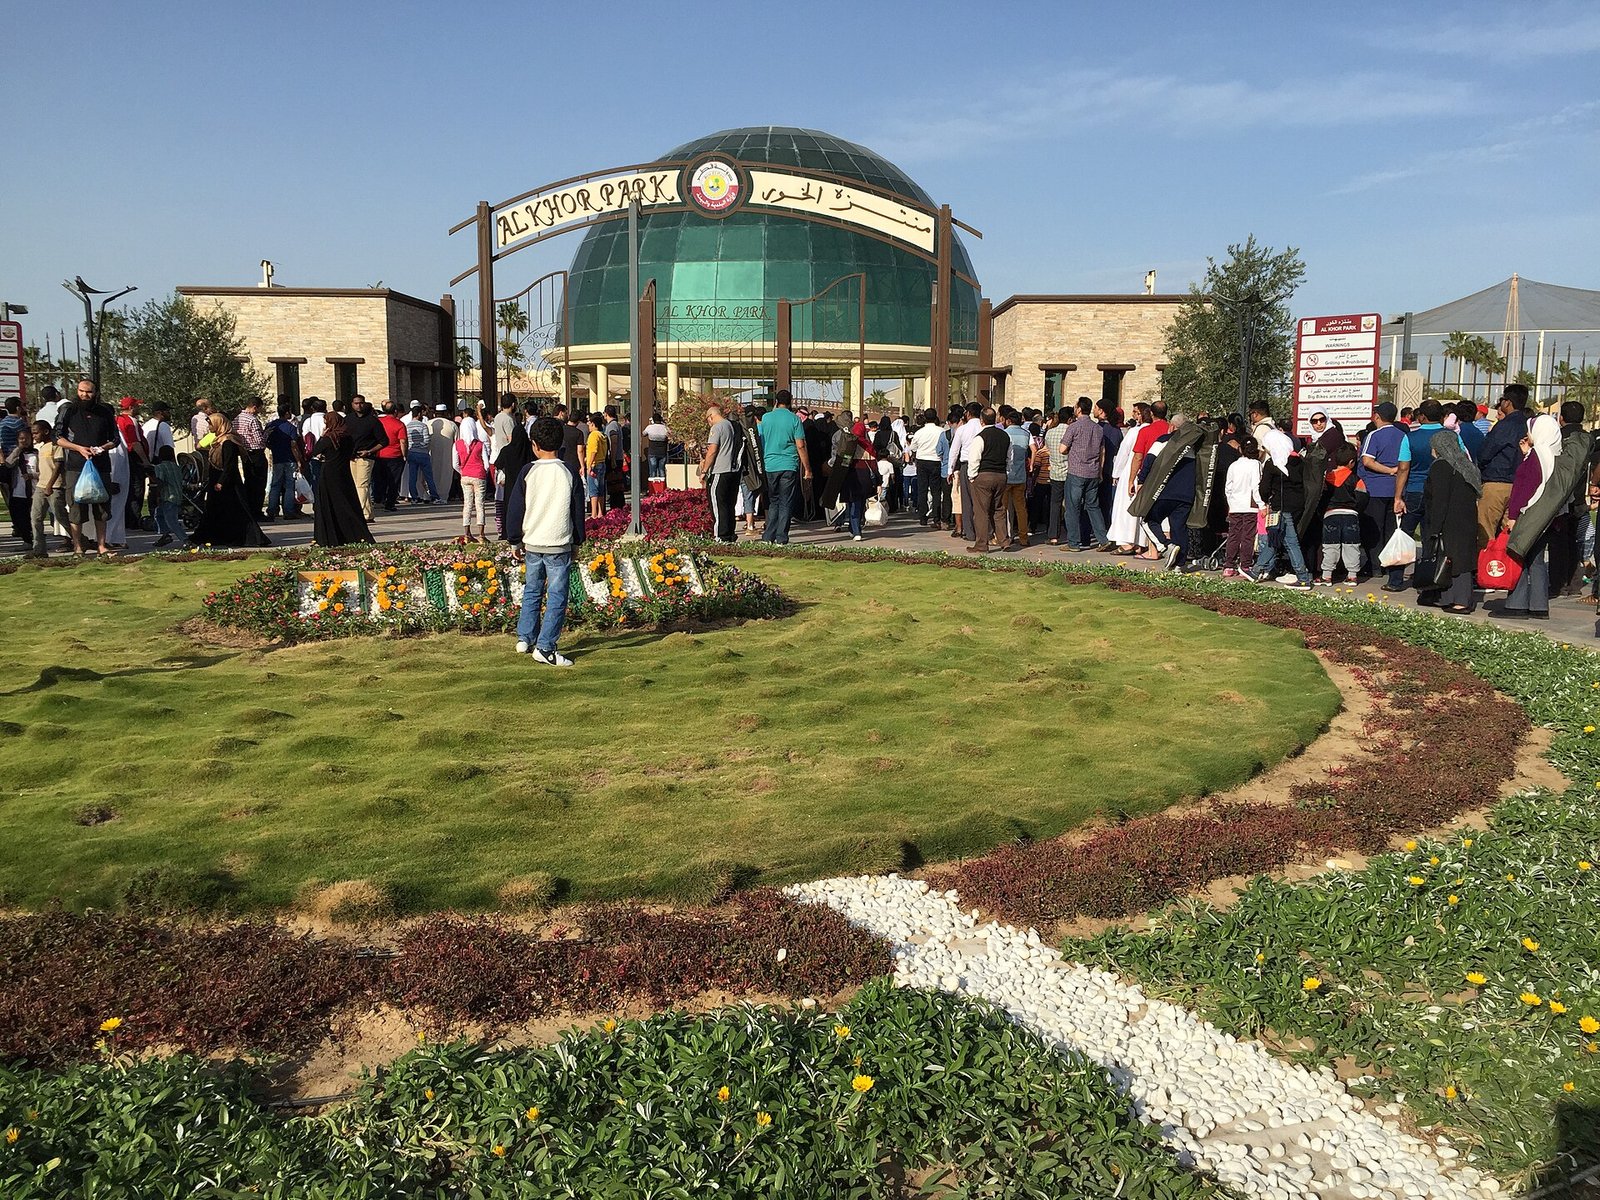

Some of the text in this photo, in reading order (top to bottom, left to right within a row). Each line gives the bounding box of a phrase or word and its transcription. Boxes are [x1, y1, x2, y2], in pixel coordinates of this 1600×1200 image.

[497, 174, 674, 245] AL KHOR PARK
[762, 182, 931, 234] منتزه الخور
[660, 304, 772, 320] AL KHOR PARK
